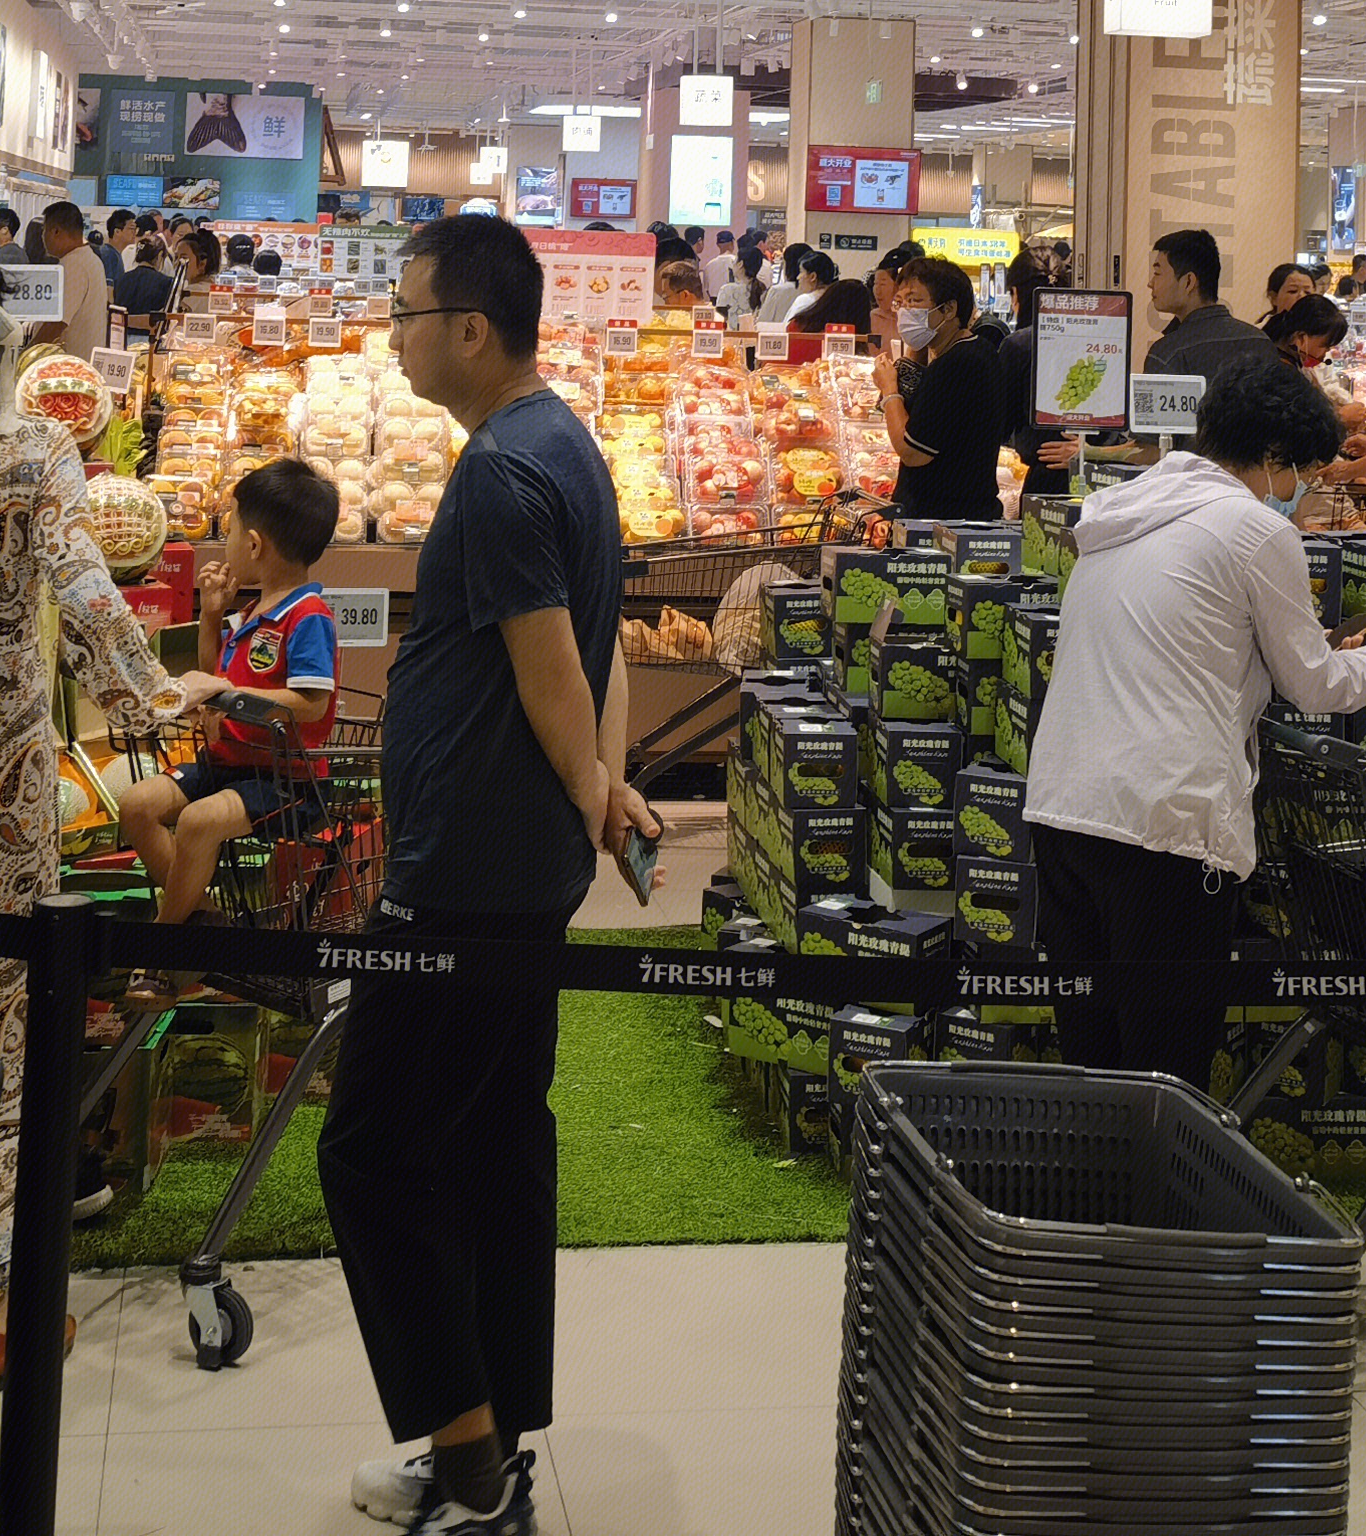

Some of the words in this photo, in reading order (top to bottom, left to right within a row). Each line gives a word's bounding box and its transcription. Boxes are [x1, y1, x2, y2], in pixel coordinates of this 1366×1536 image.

[119, 98, 167, 111] 鲜活水产
[119, 111, 167, 123] 现捞现做
[262, 115, 286, 138] 鲜
[12, 283, 53, 302] 28.80
[1039, 293, 1100, 312] 爆品推荐
[1085, 343, 1118, 354] 24.80
[106, 363, 127, 379] 19.90
[1159, 394, 1198, 413] 24.80
[886, 562, 947, 575] 阳光玫瑰青提
[340, 607, 378, 626] 39.80
[969, 783, 1019, 799] 阳光玫瑰青提
[968, 868, 1019, 883] 阳光玫瑰青提
[847, 931, 911, 958] 阳光玫瑰青提
[316, 943, 412, 972] 7FRESH
[415, 949, 456, 974] 七鲜
[638, 958, 733, 987] 7FRESH
[736, 966, 776, 989] 七鲜
[957, 970, 1050, 997] 7FRESH
[1053, 975, 1094, 997] 七鲜
[1272, 971, 1366, 997] 7FRESH
[842, 1029, 891, 1048] 阳光玫瑰青提
